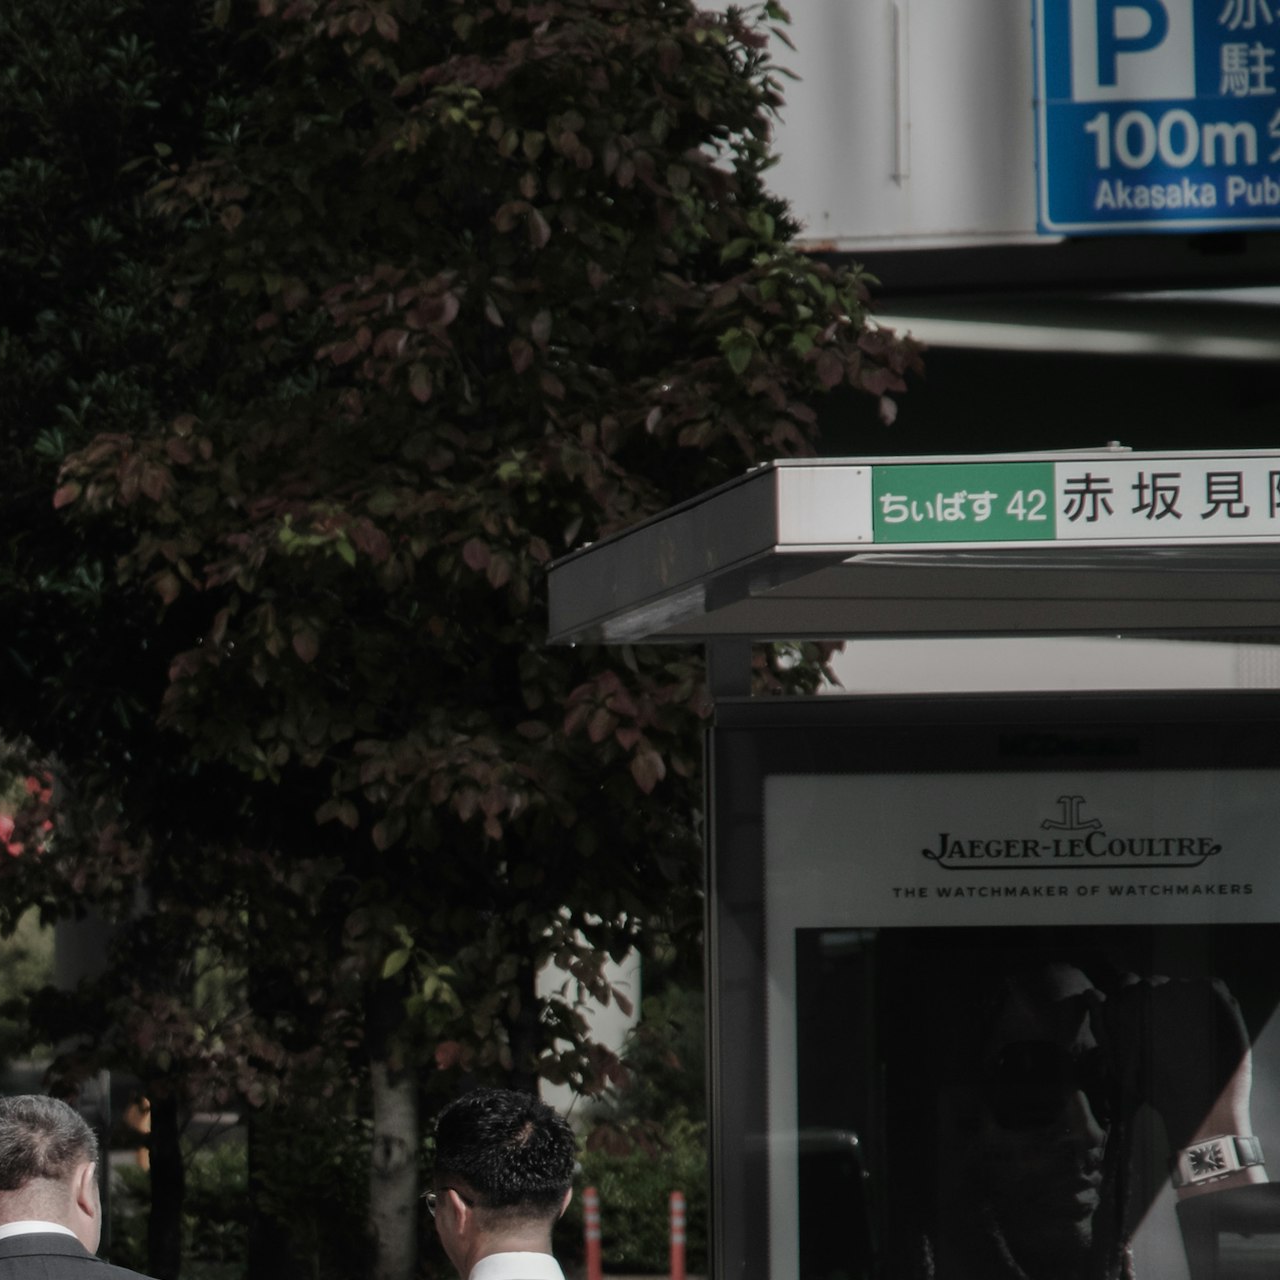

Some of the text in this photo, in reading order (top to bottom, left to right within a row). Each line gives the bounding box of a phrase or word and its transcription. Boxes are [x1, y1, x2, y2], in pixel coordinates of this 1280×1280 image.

[1219, 41, 1278, 97] 駐
[1084, 108, 1280, 170] 100m
[1095, 174, 1280, 211] Akasaka Pub
[1005, 489, 1047, 521] 42
[1064, 470, 1280, 522] 赤坂見
[893, 883, 1254, 898] THE WATCHMAKER OF WATCHMAKERS
